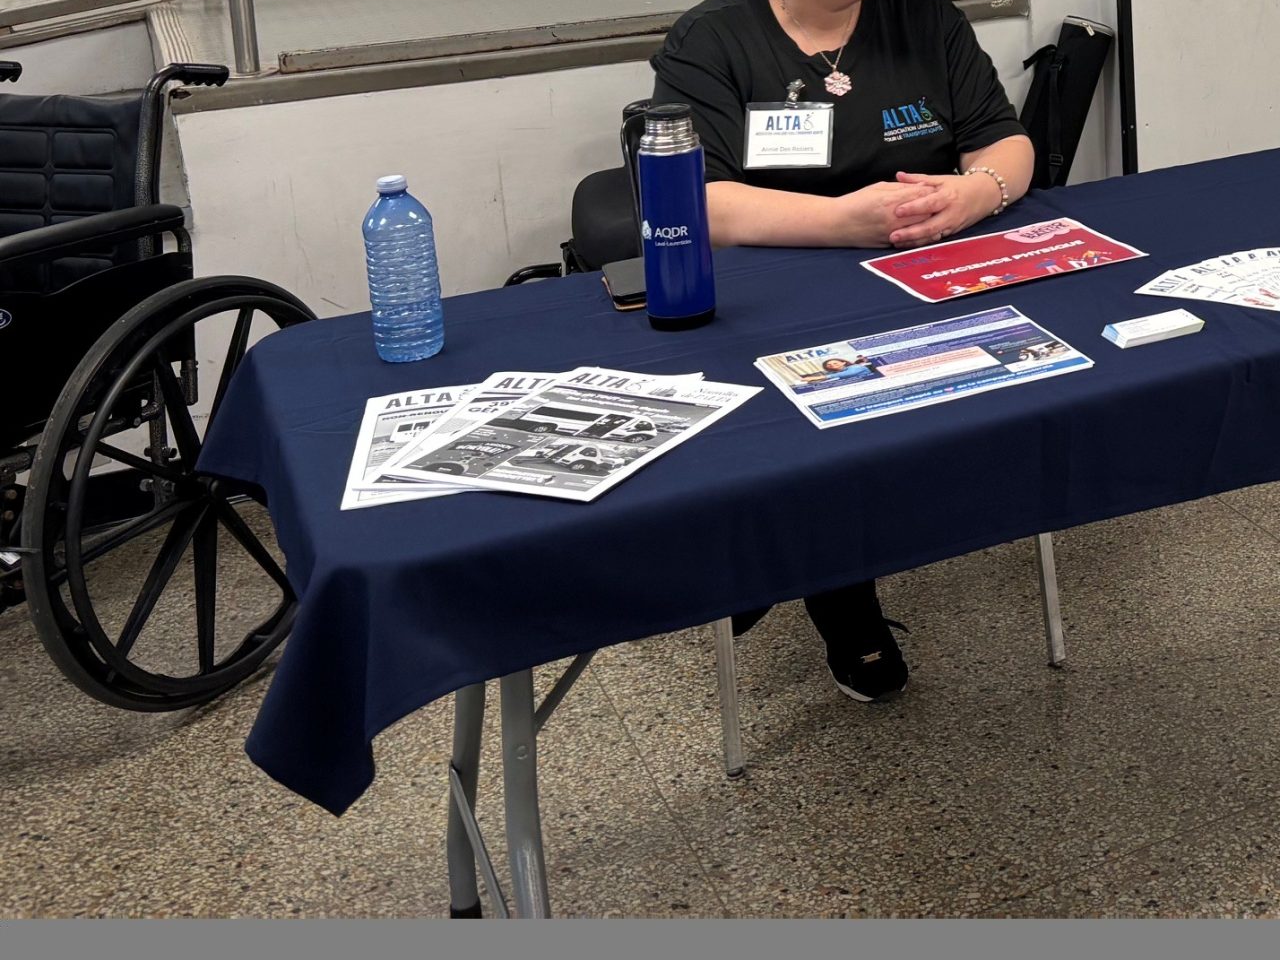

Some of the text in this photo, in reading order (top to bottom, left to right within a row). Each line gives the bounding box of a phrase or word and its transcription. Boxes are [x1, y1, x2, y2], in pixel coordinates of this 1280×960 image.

[765, 115, 802, 131] ALTA
[881, 103, 924, 130] ALTA
[654, 225, 689, 240] AQDR
[920, 239, 1086, 280] DÉFICIENCE PHYSIQUE
[785, 347, 826, 364] ALTA
[568, 372, 631, 389] ALTA
[385, 391, 453, 410] ALTA
